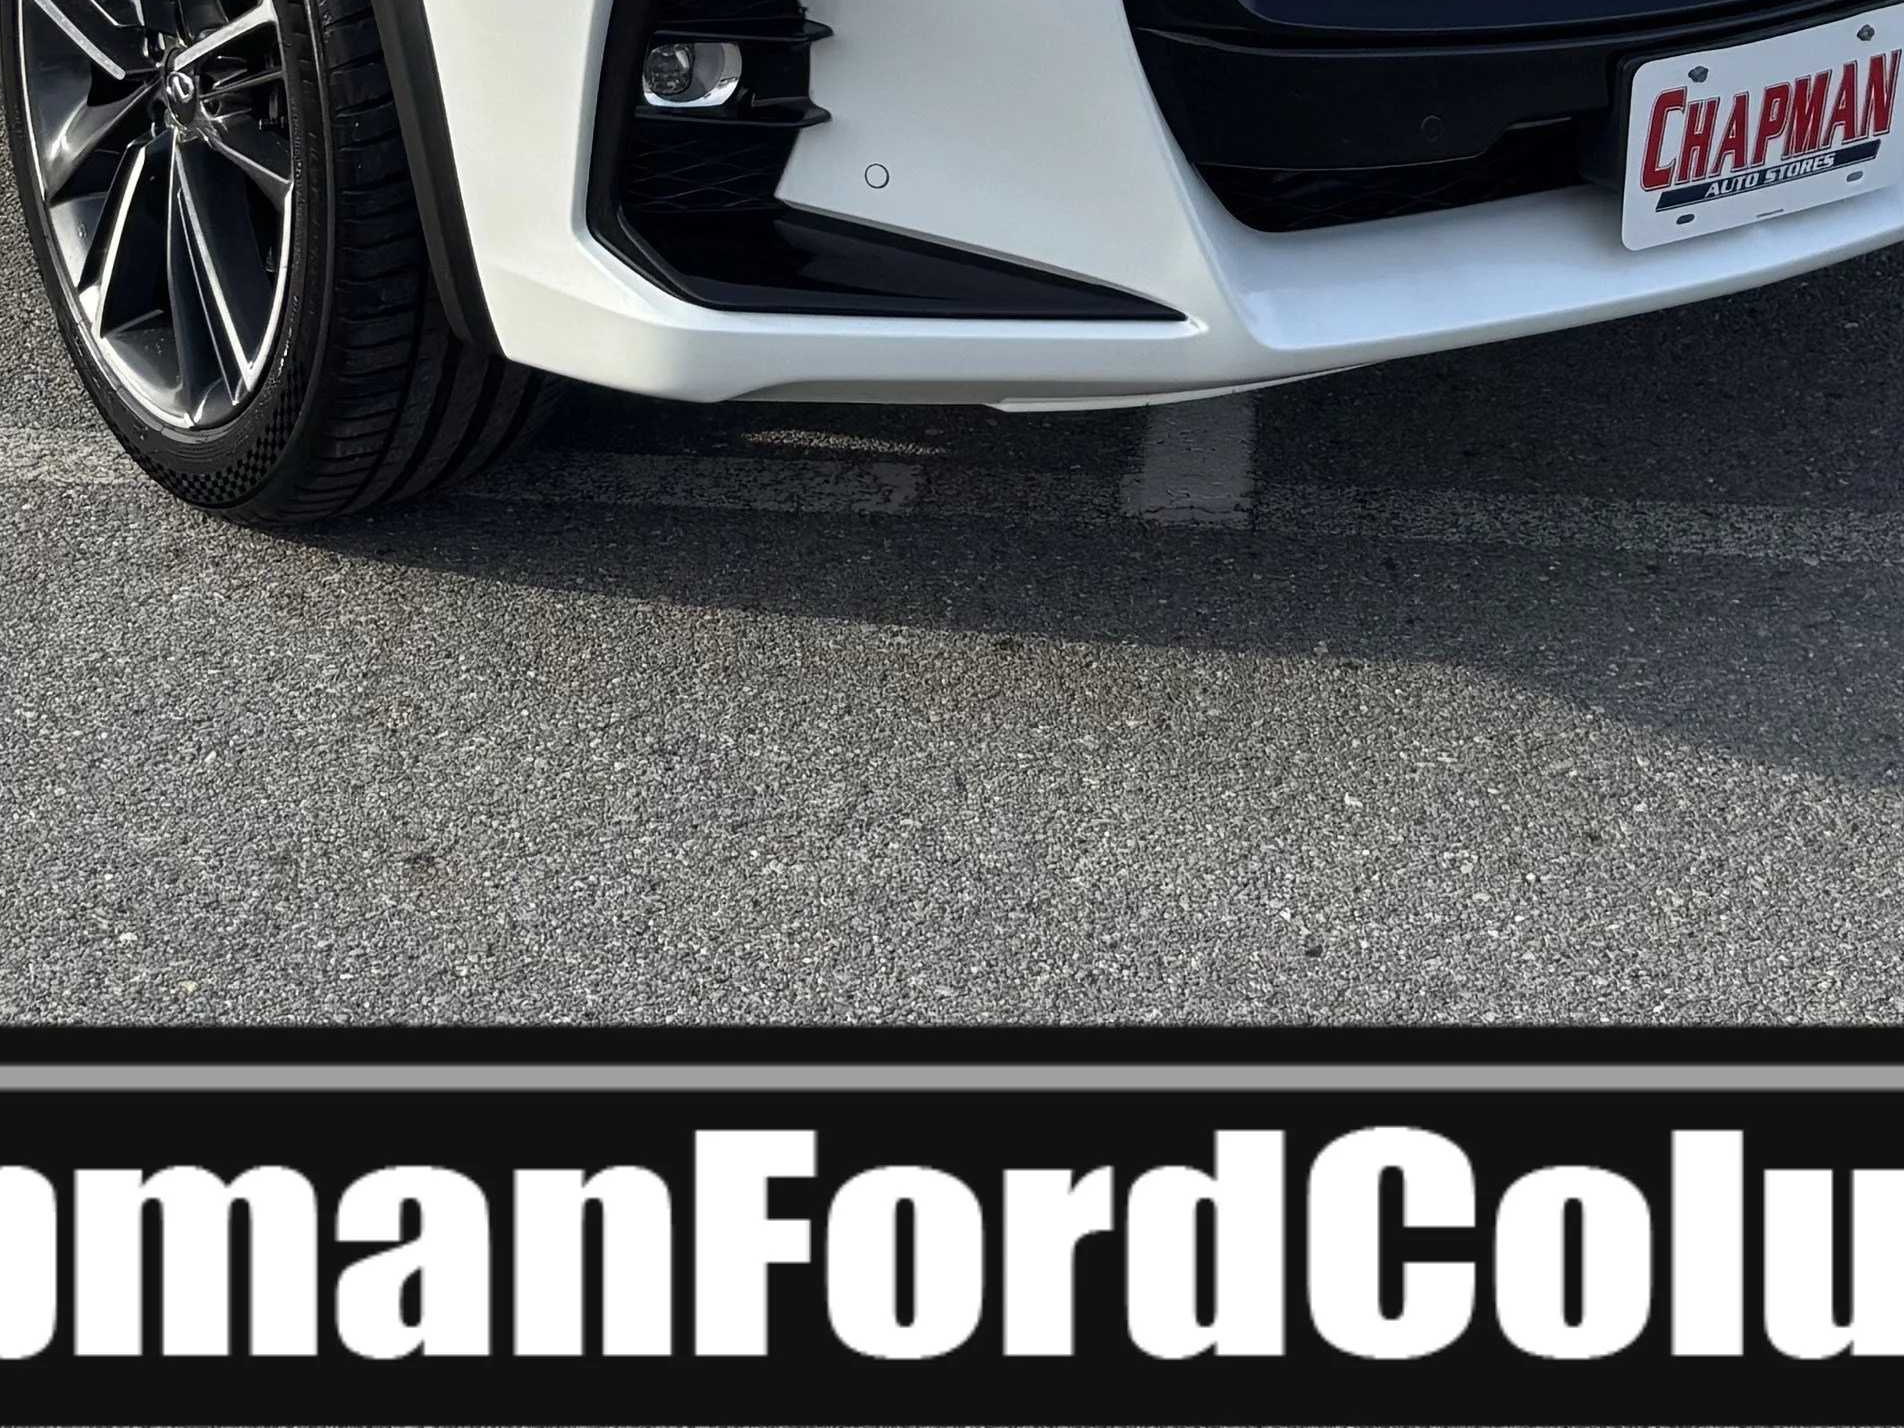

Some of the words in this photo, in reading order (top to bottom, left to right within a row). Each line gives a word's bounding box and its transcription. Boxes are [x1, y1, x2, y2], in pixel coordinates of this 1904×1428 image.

[1640, 48, 1903, 192] CHAPMAN
[1703, 171, 1760, 200] AUTO
[1763, 151, 1837, 183] STORES
